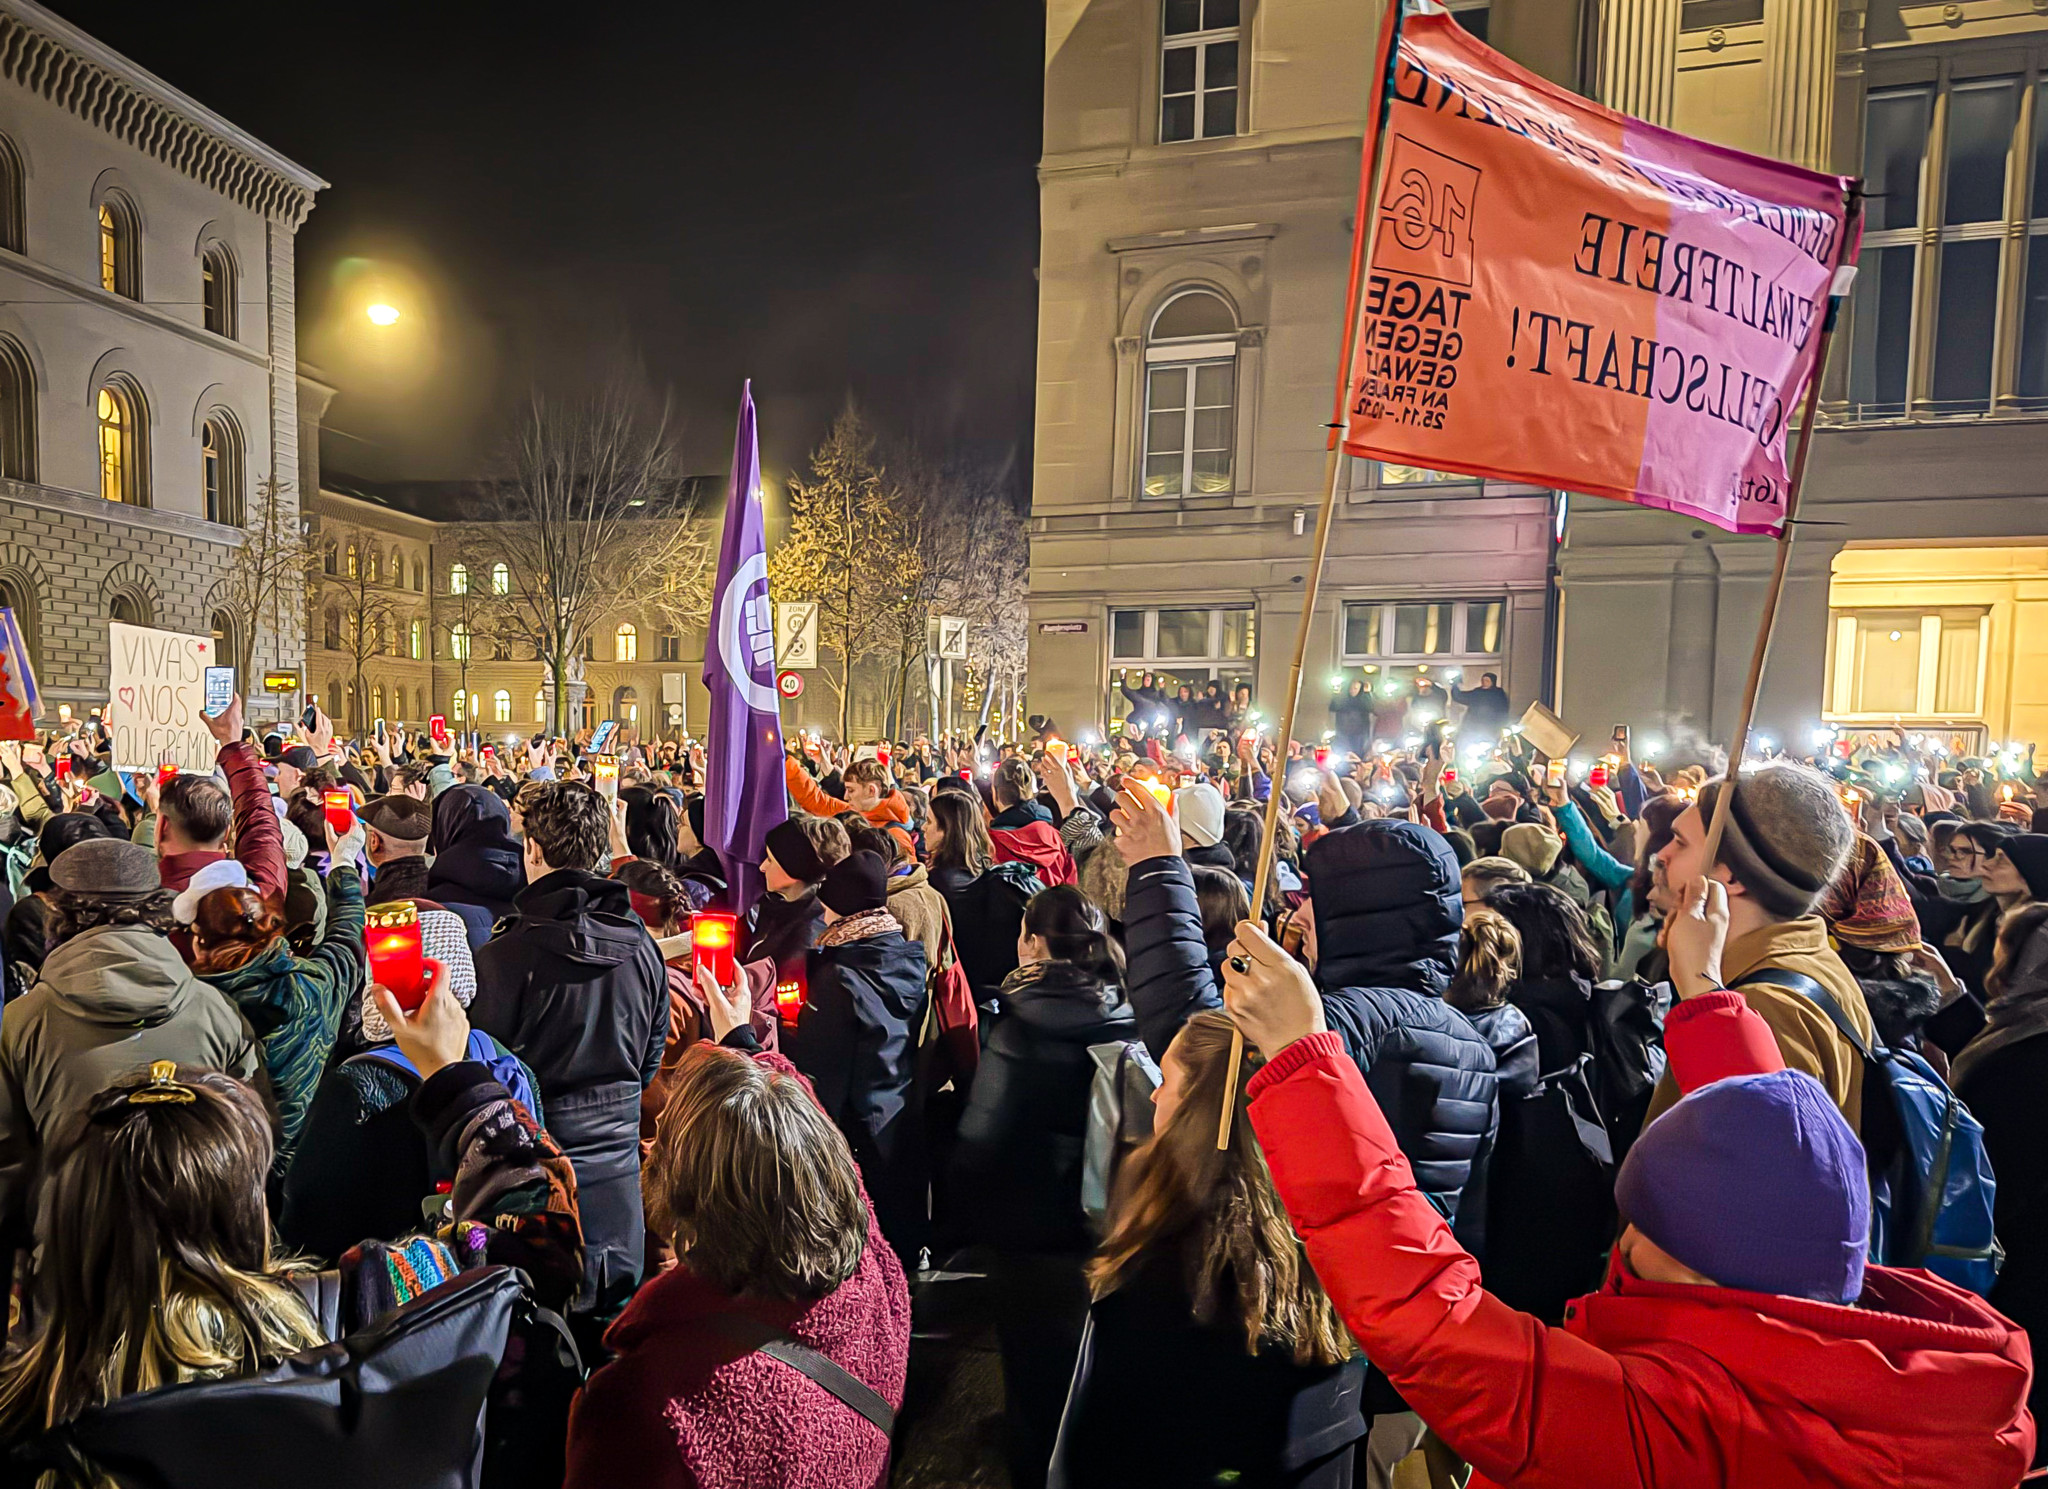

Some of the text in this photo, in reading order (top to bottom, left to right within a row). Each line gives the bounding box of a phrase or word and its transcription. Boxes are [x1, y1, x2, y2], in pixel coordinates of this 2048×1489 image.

[788, 605, 806, 613] ZONE
[121, 634, 200, 683] VIVAS
[139, 684, 189, 728] NOS
[784, 679, 796, 690] 40
[115, 725, 214, 771] QUEREMOS
